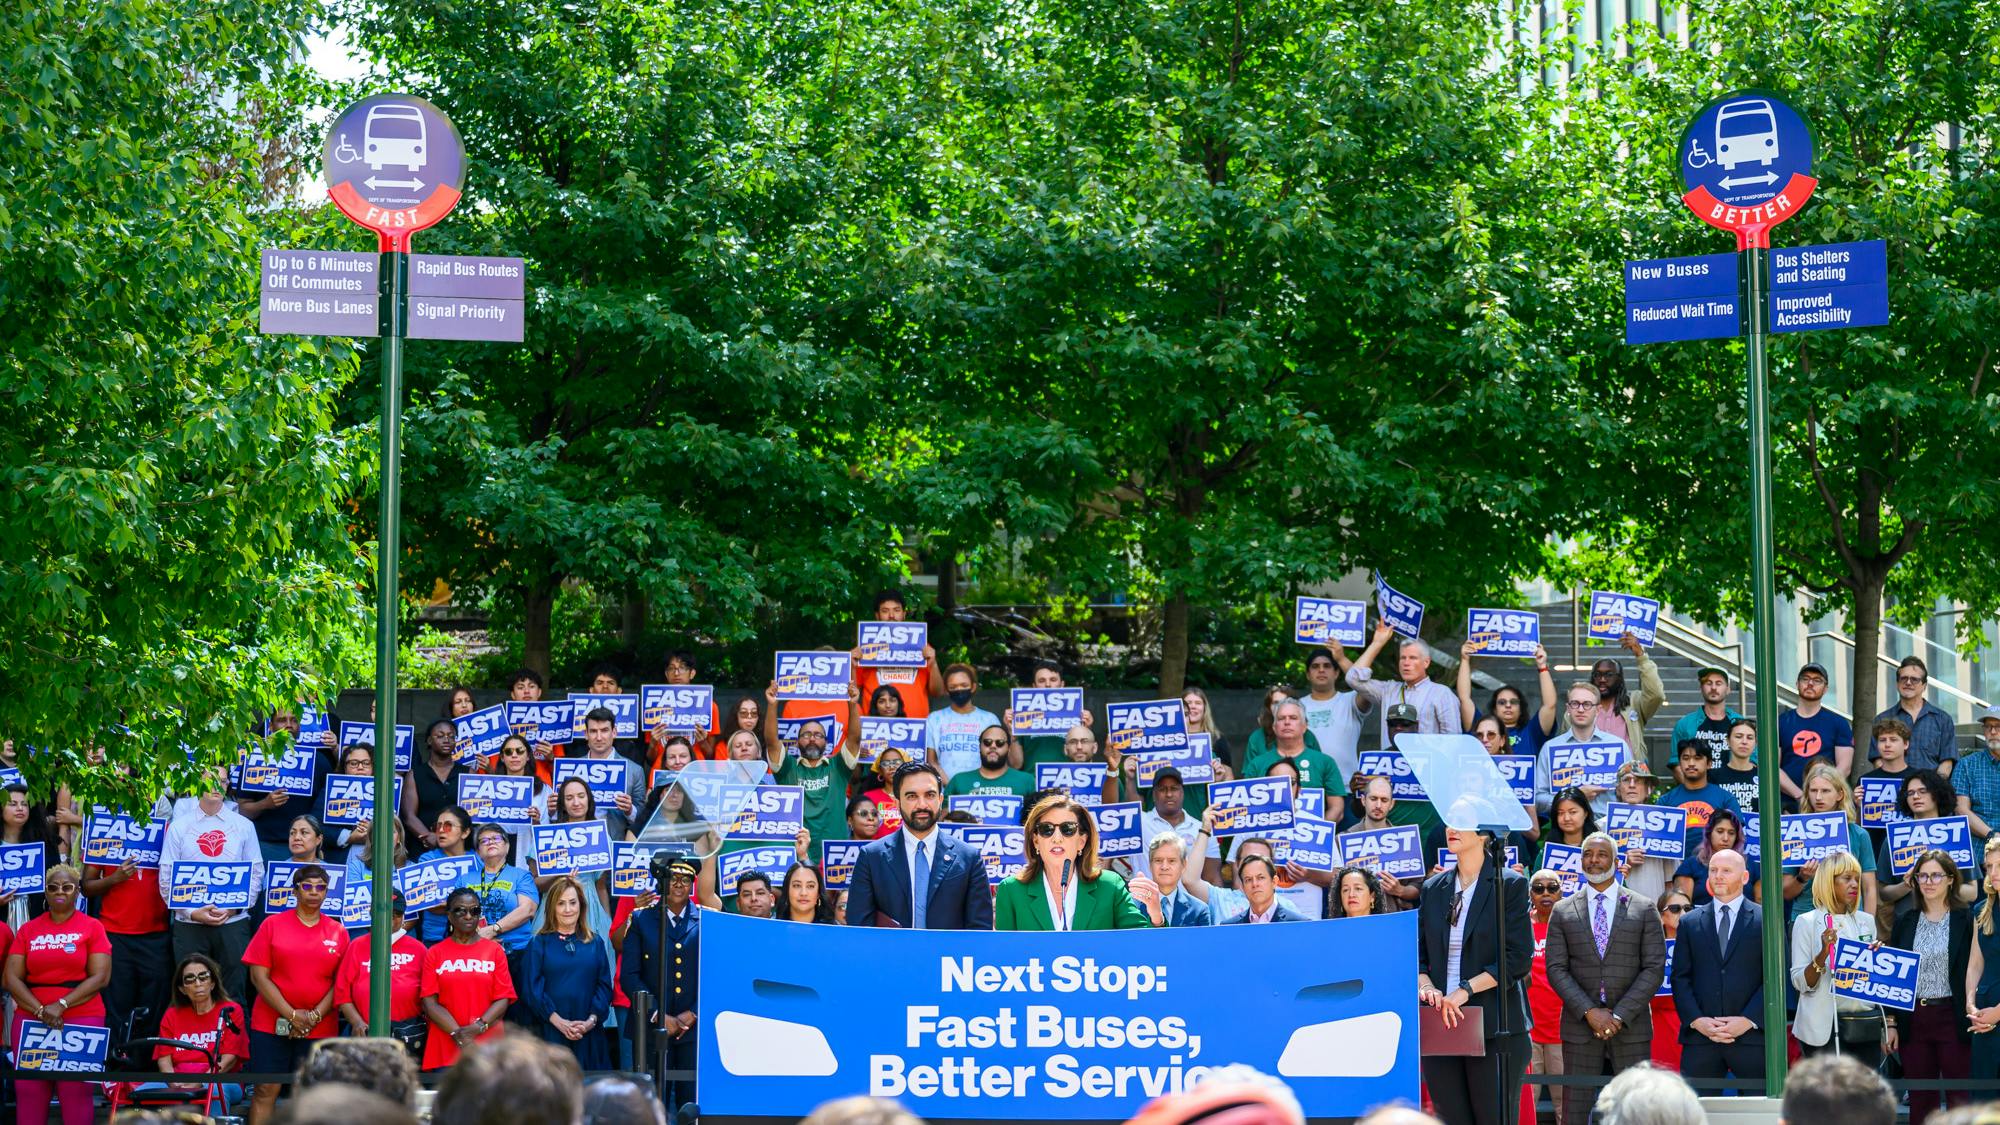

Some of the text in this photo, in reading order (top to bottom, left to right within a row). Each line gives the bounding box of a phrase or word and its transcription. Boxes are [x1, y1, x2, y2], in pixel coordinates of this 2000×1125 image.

[365, 206, 417, 227] FAST
[1710, 194, 1792, 225] BETTER
[269, 256, 373, 273] Up to 6 Minutes
[417, 260, 519, 278] Rapid Bus Routes
[1776, 250, 1850, 268] Bus Shelters
[1631, 262, 1709, 280] New Buses
[1776, 267, 1846, 284] and Seating
[269, 275, 362, 291] Off Commutes
[268, 298, 373, 315] More Bus Lanes
[416, 302, 505, 322] Signal Priority
[1632, 302, 1733, 322] Reduced Wait Time
[1776, 293, 1832, 313] Improved
[1776, 308, 1852, 327] Accessibility
[1300, 602, 1363, 624] FAST
[1594, 596, 1656, 622] FAST
[1471, 613, 1536, 634] FAST
[861, 626, 924, 645] FAST
[1314, 627, 1362, 642] BUSES
[1487, 639, 1538, 652] BUSES
[779, 656, 848, 676] FAST
[875, 650, 923, 663] BUSES
[645, 689, 709, 708] FAST
[795, 682, 849, 695] BUSES
[1016, 692, 1080, 712] FAST
[456, 709, 503, 740] AST
[510, 705, 573, 724] FAST
[660, 714, 710, 726] BUSES
[1031, 717, 1082, 730] BUSES
[1112, 705, 1180, 730] FAST
[343, 726, 411, 749] FAT
[526, 728, 572, 742] BUSES
[861, 722, 924, 742] FAST
[1130, 733, 1186, 750] BUSES
[1553, 747, 1622, 769] FAST
[262, 775, 312, 791] BUSES
[1040, 767, 1107, 788] FAST
[462, 780, 531, 800] FAST
[1213, 782, 1288, 808] FAST
[722, 790, 800, 813] FAST
[477, 806, 530, 820] BUSES
[1233, 811, 1292, 829] BUSES
[1610, 808, 1683, 834] FAST
[88, 819, 161, 843] FAST
[740, 820, 800, 835] BUSES
[1894, 822, 1966, 849] FAST
[538, 826, 604, 850] FAST
[1346, 830, 1416, 859] FAST
[1627, 837, 1682, 854] BUSES
[102, 847, 160, 863] BUSES
[556, 852, 610, 869] BUSES
[723, 850, 794, 874] FAST
[1275, 848, 1331, 866] BUSES
[175, 865, 250, 886] FAST
[192, 891, 249, 905] BUSES
[30, 933, 80, 945] AARP
[436, 958, 496, 975] AARP
[1838, 944, 1917, 980] FAST
[941, 955, 1168, 1000] Next Stop:
[1851, 978, 1913, 1003] BUSES
[24, 1026, 107, 1054] FAST
[906, 1004, 1202, 1058] Fast Buses,
[870, 1053, 1214, 1098] Better Servic
